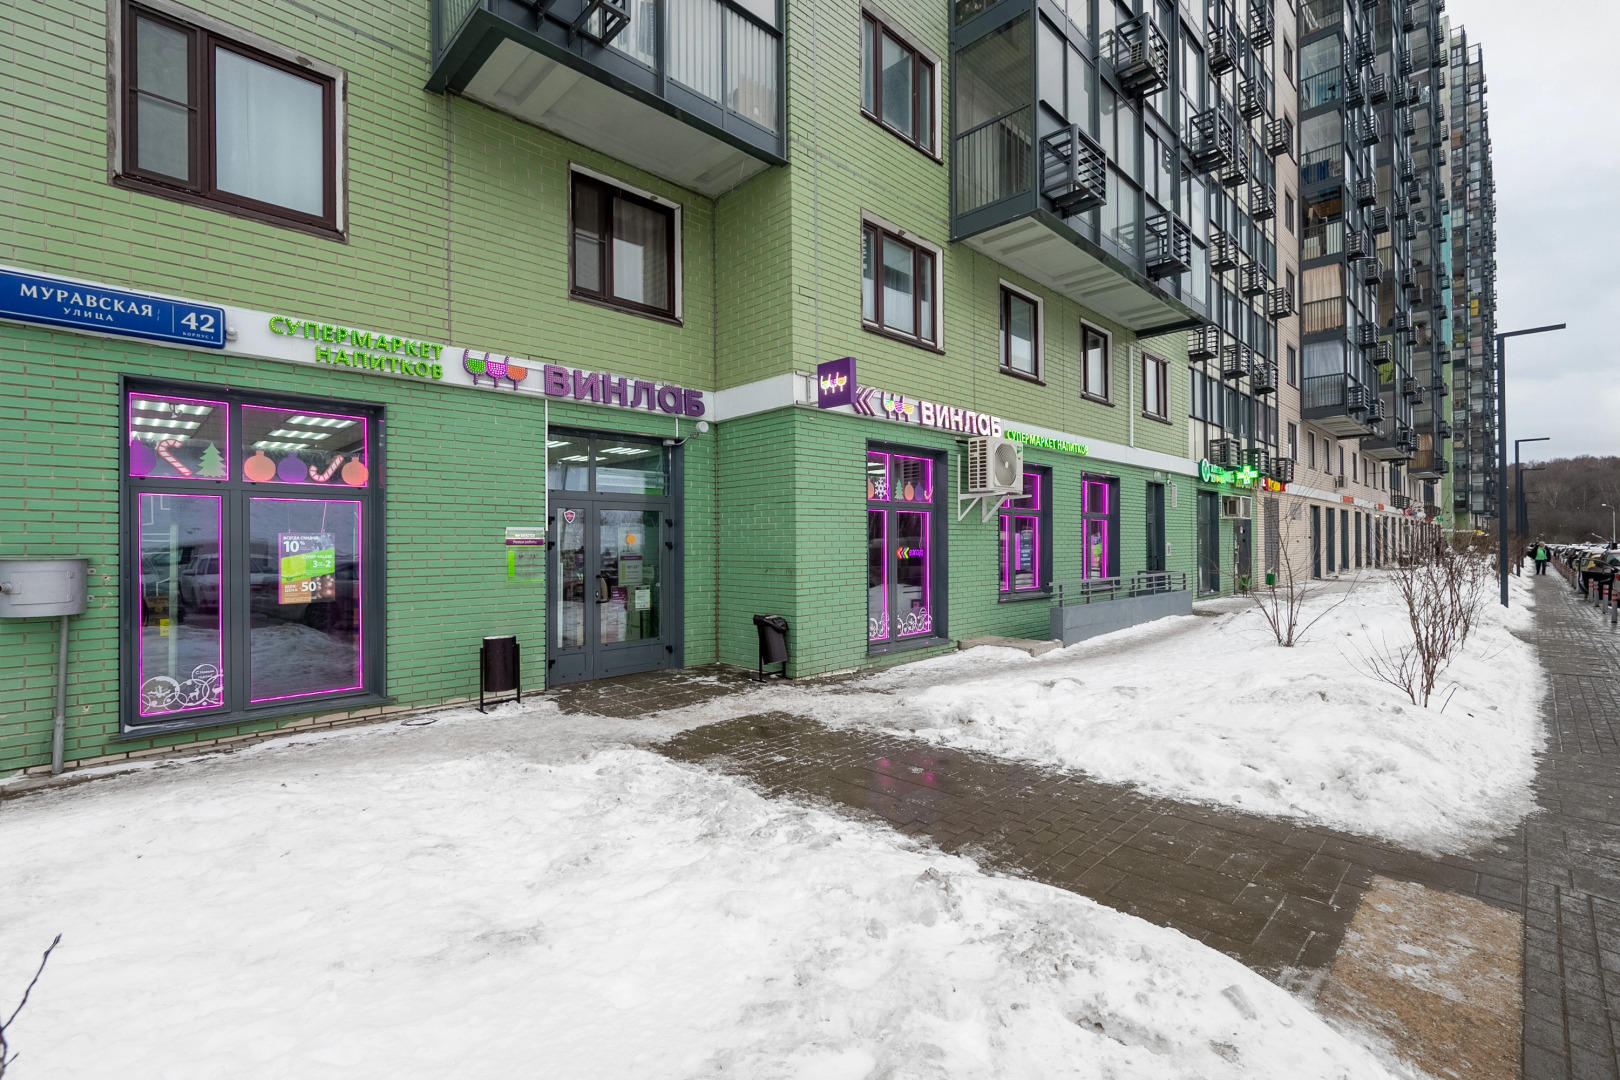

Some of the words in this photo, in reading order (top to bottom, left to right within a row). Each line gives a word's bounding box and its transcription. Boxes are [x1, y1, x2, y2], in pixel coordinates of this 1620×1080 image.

[20, 283, 153, 317] МУРАВСКАЯ
[63, 307, 114, 322] УЛИЦА
[180, 312, 215, 333] 42
[182, 331, 209, 339] КОРПУС
[269, 316, 443, 360] СУПЕРМАРКЕТ
[315, 345, 443, 379] НАПИТКОВ
[1004, 429, 1056, 449] СУПЕРМАРКЕТ
